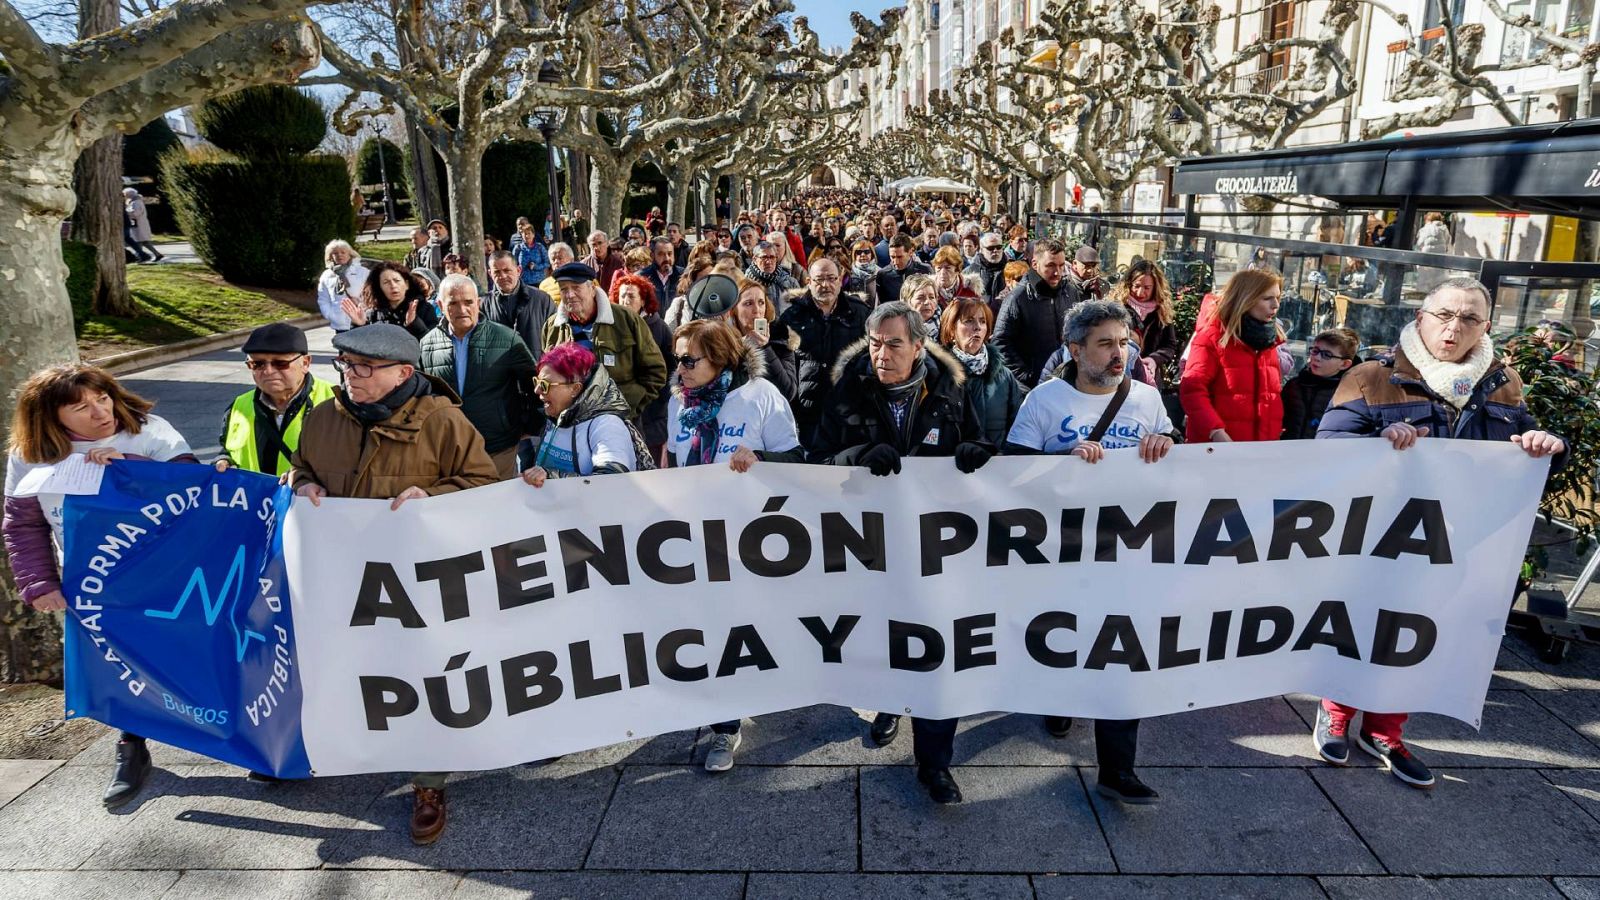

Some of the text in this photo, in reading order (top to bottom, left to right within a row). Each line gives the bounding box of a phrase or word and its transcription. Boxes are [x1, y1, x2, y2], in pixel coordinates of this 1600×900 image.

[1215, 171, 1298, 194] CHOCOLATERÍA
[676, 422, 746, 443] Sdad
[1057, 415, 1140, 443] Sadad
[140, 486, 202, 526] POR
[212, 483, 249, 511] LA
[257, 498, 282, 613] SAAD
[350, 495, 1453, 629] ATENCIÓN PRIMARIA
[75, 521, 147, 697] PLATAFORMA
[245, 624, 292, 727] PÚBLICA
[358, 600, 1438, 731] PÚBLICA Y DE CALIDAD
[162, 693, 229, 725] Burgos
